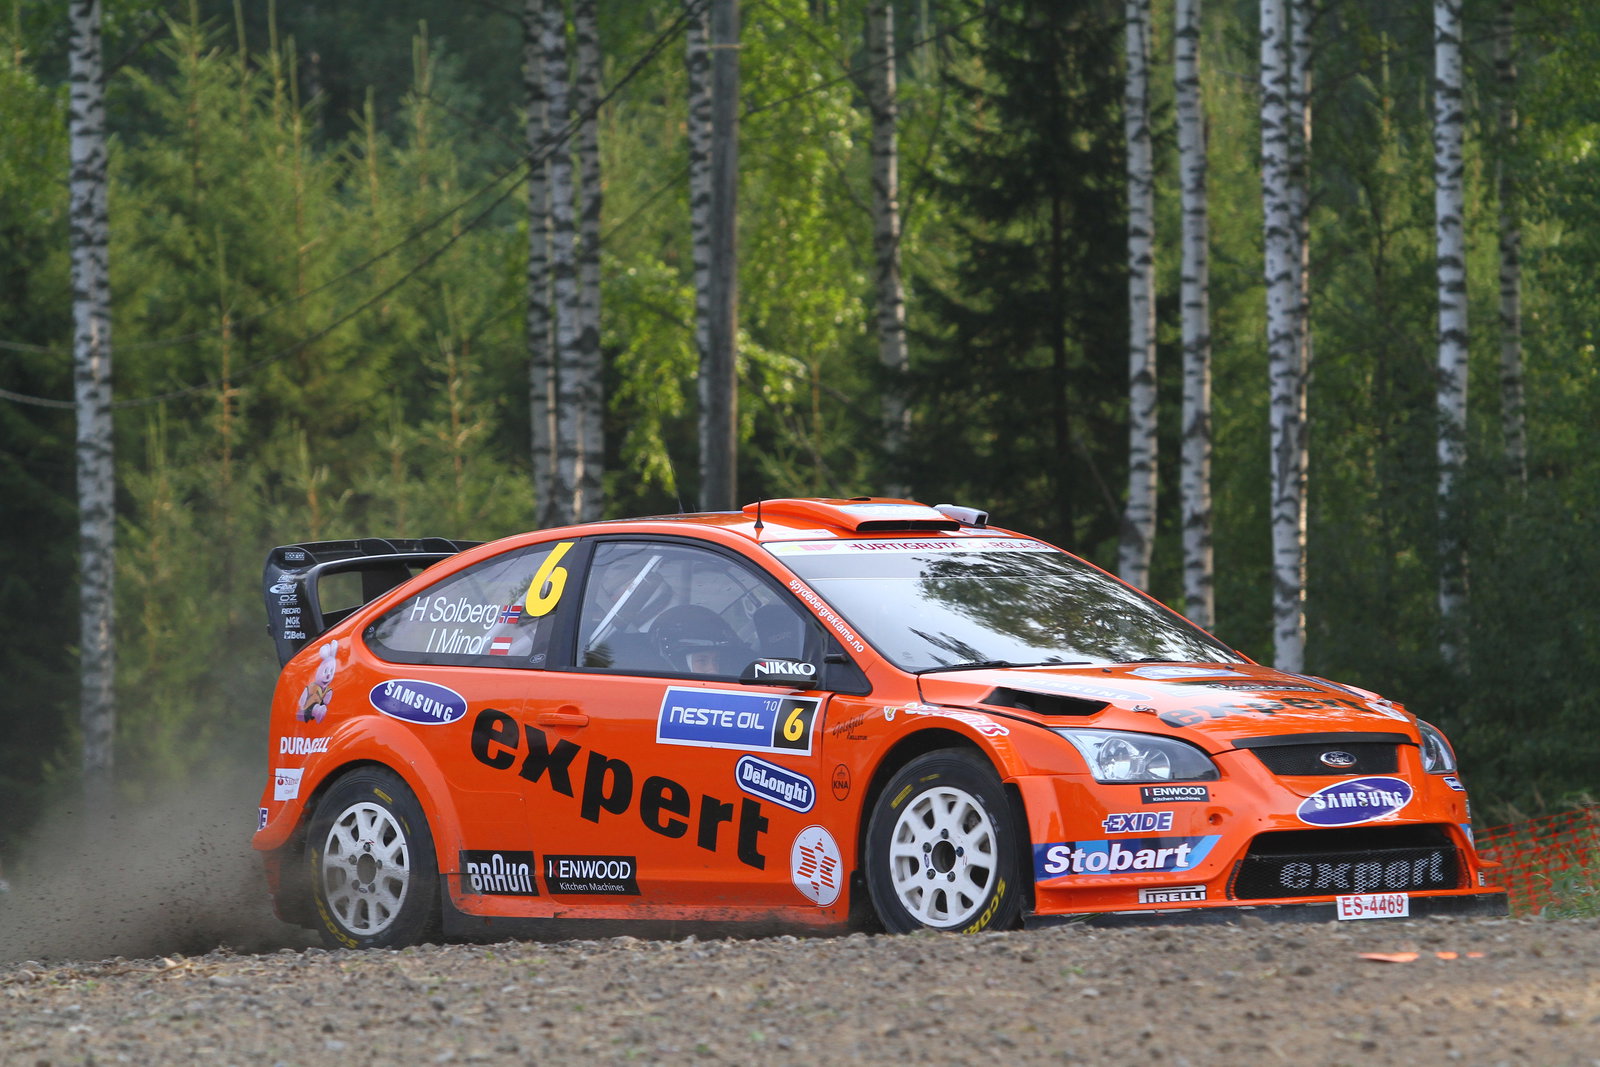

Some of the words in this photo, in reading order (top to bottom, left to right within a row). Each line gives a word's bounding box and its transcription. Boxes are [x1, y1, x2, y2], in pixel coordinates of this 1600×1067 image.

[525, 542, 575, 617] 6
[410, 597, 430, 621] H
[430, 597, 500, 630] Solberg
[789, 579, 864, 653] spydebergreklame.no
[426, 628, 437, 653] I
[435, 628, 490, 655] Minor
[754, 661, 816, 678] NIKKO
[384, 681, 453, 722] SAMSUNG
[1158, 697, 1375, 728] expert
[670, 707, 733, 728] NESTE
[737, 713, 765, 730] OIL
[783, 707, 804, 741] 6
[280, 736, 331, 755] DURACELL
[471, 708, 769, 871] expert
[832, 779, 849, 790] KNA
[1144, 787, 1206, 796] KENWOOD
[1314, 791, 1404, 810] SAMSUNG
[1103, 812, 1173, 832] EXIDE
[549, 860, 631, 879] KENWOOD
[1044, 842, 1191, 874] Stobart
[1279, 851, 1444, 894] expert
[559, 882, 588, 891] Kitchen
[589, 882, 625, 892] Machines
[1139, 885, 1206, 904] PIRELLI
[1341, 894, 1404, 916] ES-4469
